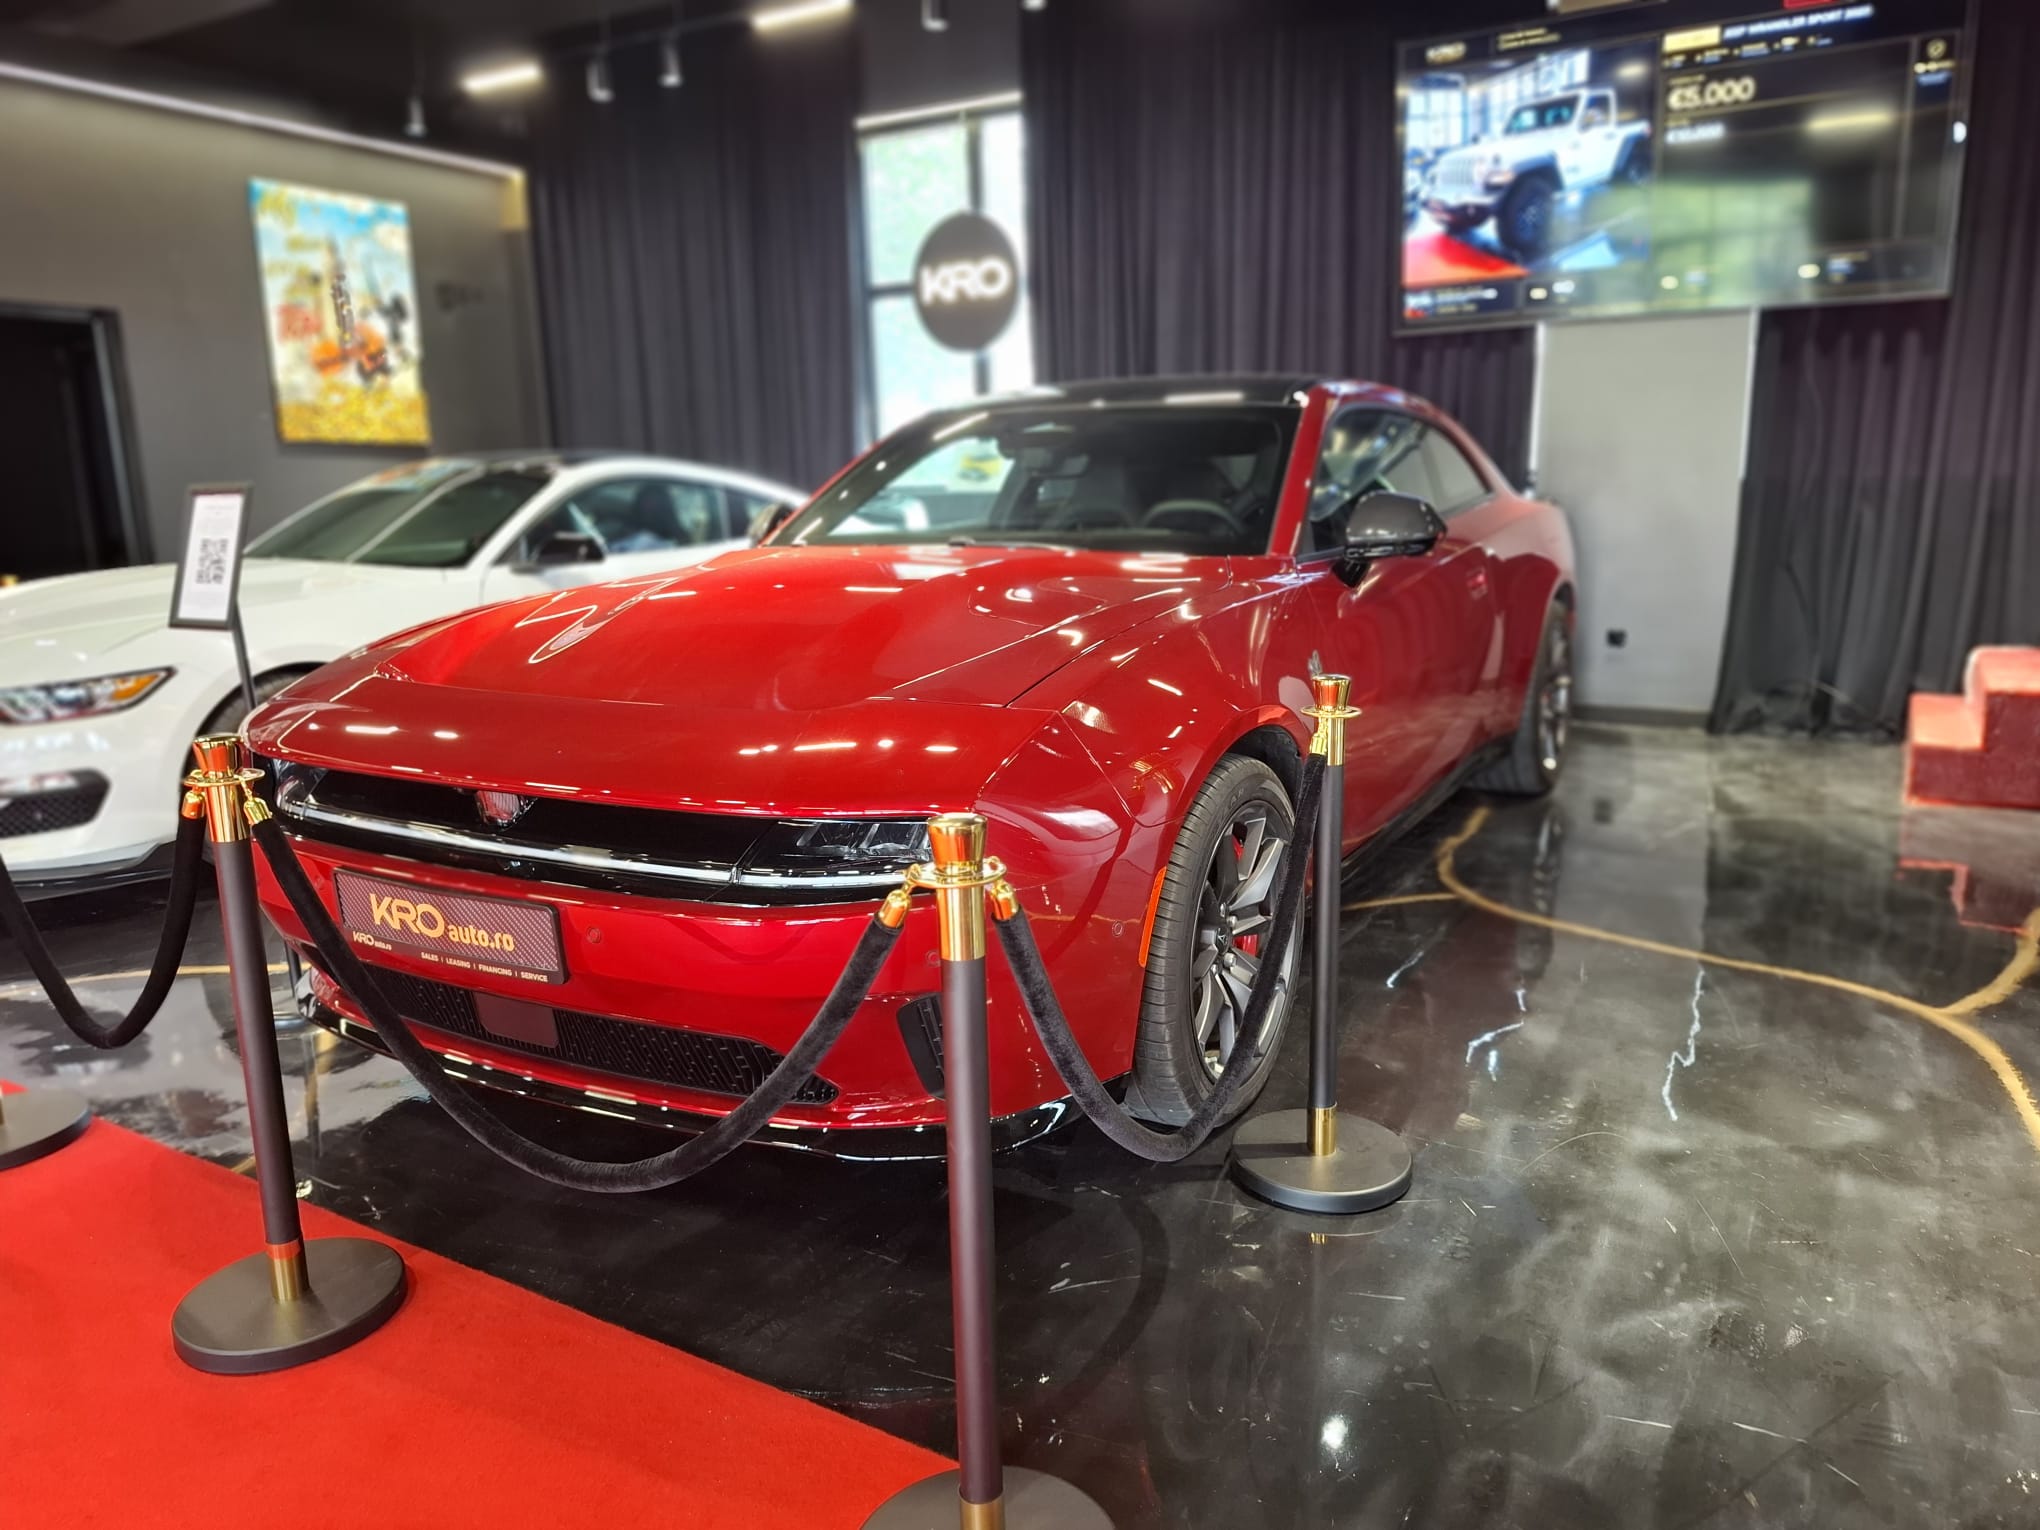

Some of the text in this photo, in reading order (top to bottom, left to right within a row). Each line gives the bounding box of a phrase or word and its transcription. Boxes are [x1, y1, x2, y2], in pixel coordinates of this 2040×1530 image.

[920, 255, 1012, 305] KRO
[353, 931, 374, 946] KRO
[369, 893, 515, 952] KRO auto.ro
[421, 952, 548, 983] SALES LEASING FINANCING SERVICE
